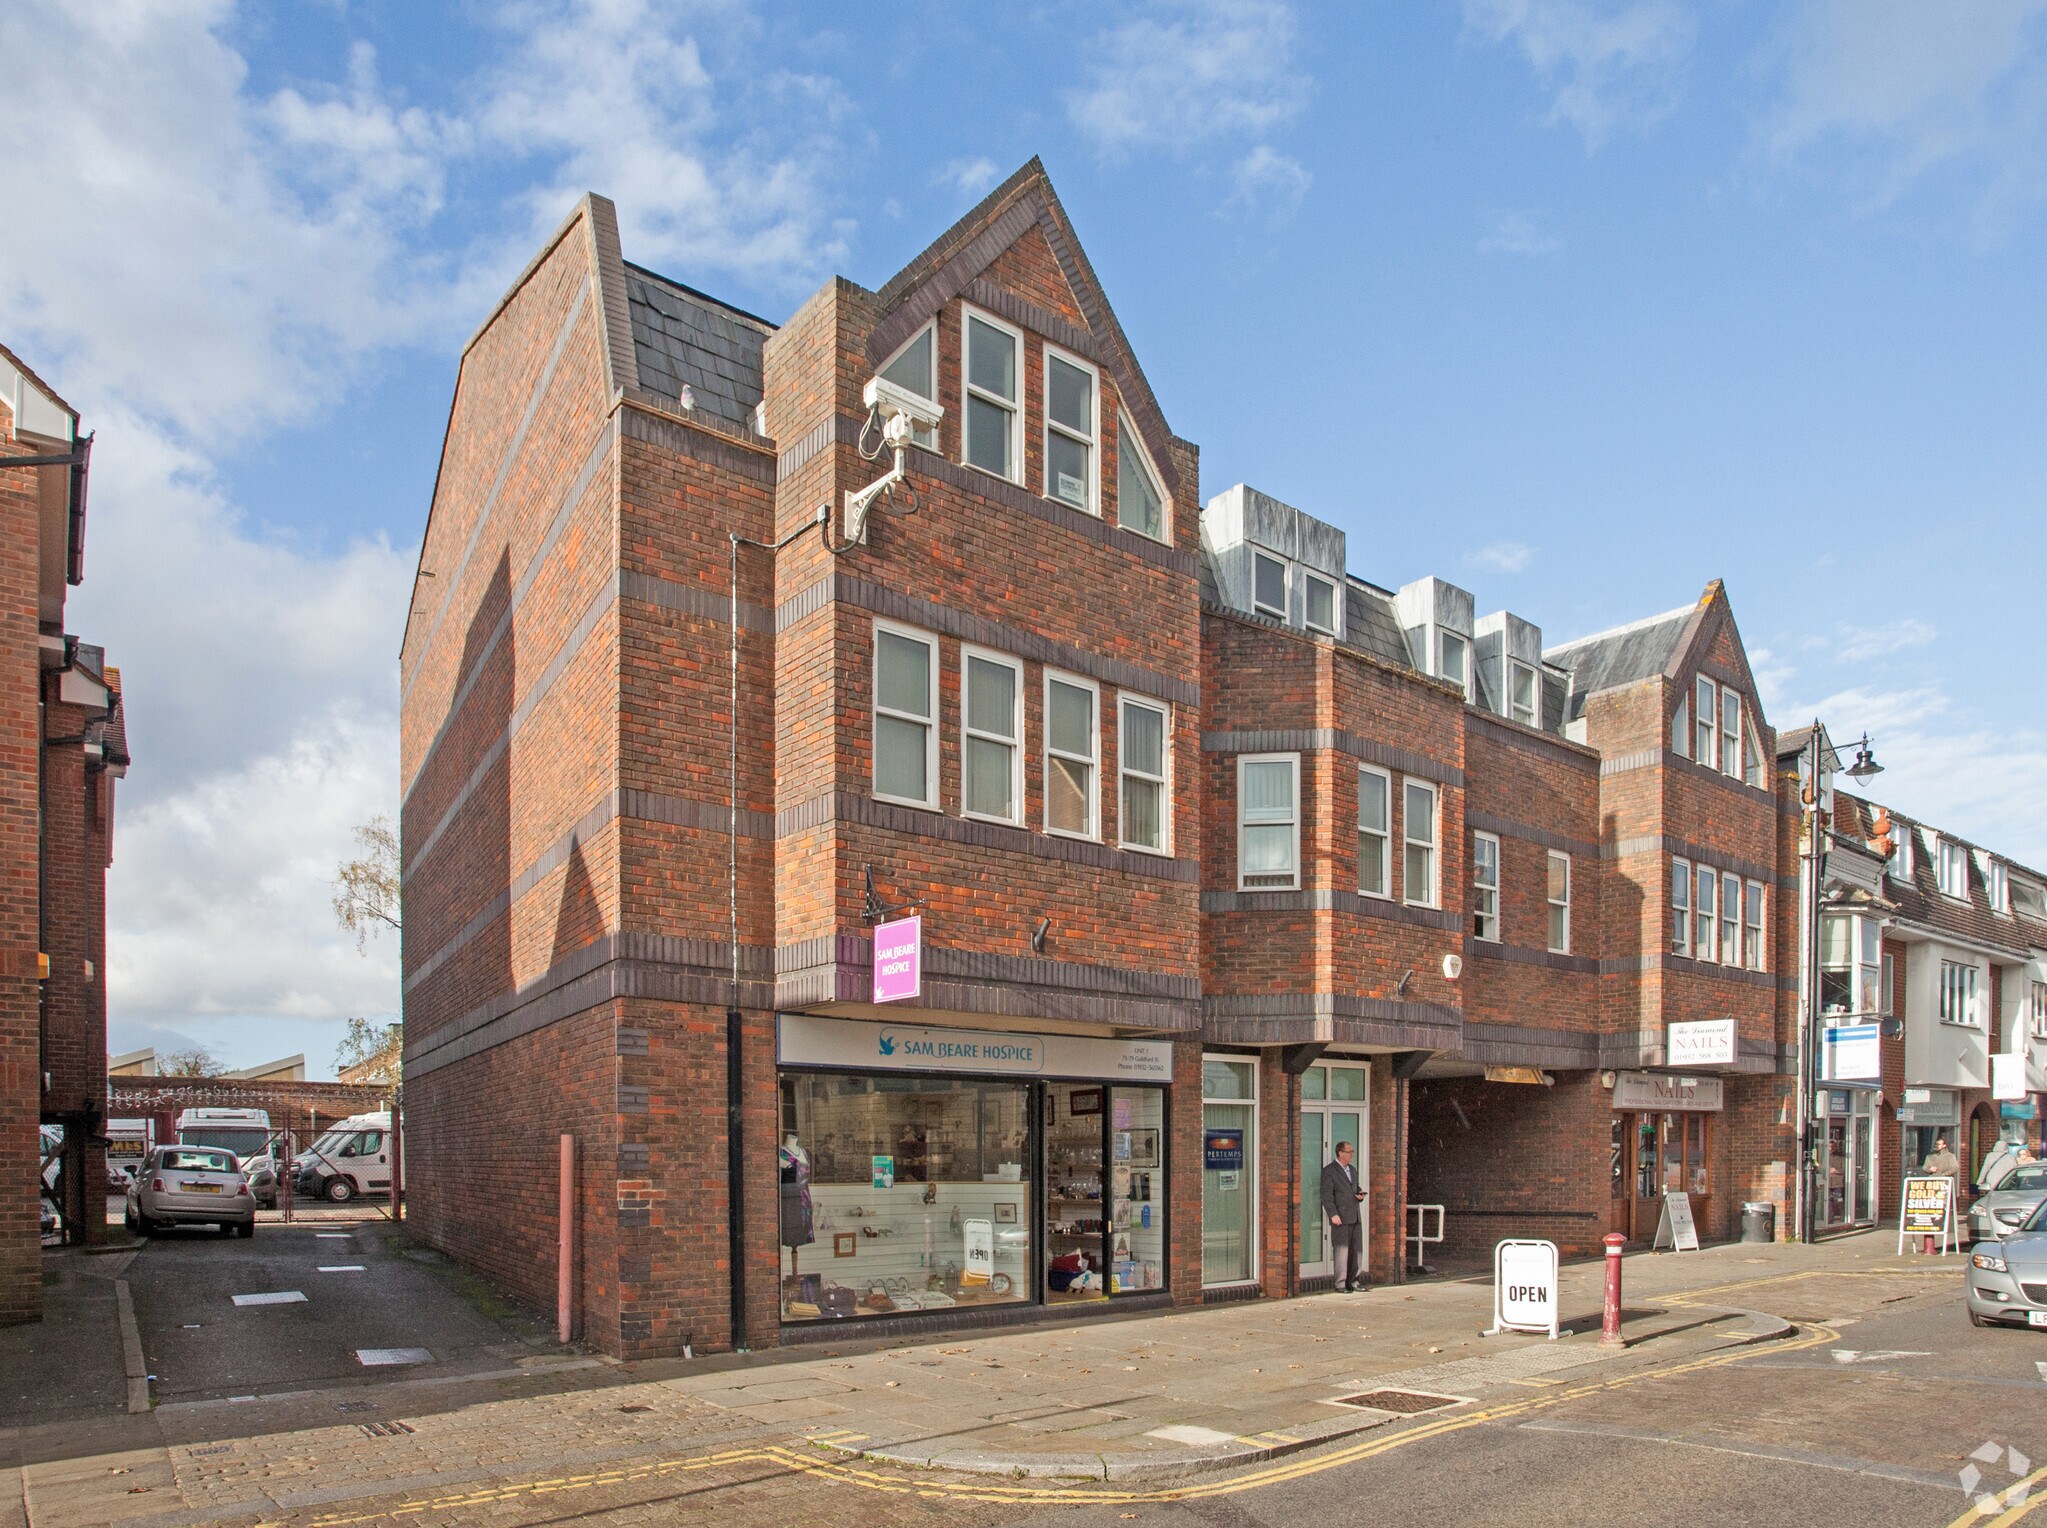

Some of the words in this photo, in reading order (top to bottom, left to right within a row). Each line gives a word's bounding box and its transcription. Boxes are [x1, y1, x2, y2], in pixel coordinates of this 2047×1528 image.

[877, 948, 892, 961] SAM
[891, 943, 916, 959] BEARE
[882, 961, 910, 976] HOSPICE
[1675, 1027, 1688, 1035] The
[1692, 1024, 1728, 1034] Diamond
[1675, 1035, 1728, 1049] NAILS
[904, 1040, 934, 1055] SAM
[932, 1042, 979, 1058] BEARE
[982, 1044, 1033, 1061] HOSPICE
[1654, 1081, 1695, 1099] NAILS
[1207, 1150, 1242, 1158] PERTEMPS
[1910, 1181, 1926, 1190] WE
[1926, 1181, 1947, 1190] BUY
[1908, 1190, 1936, 1199] GOLD
[1907, 1198, 1945, 1209] SILVER
[1509, 1285, 1547, 1303] OPEN
